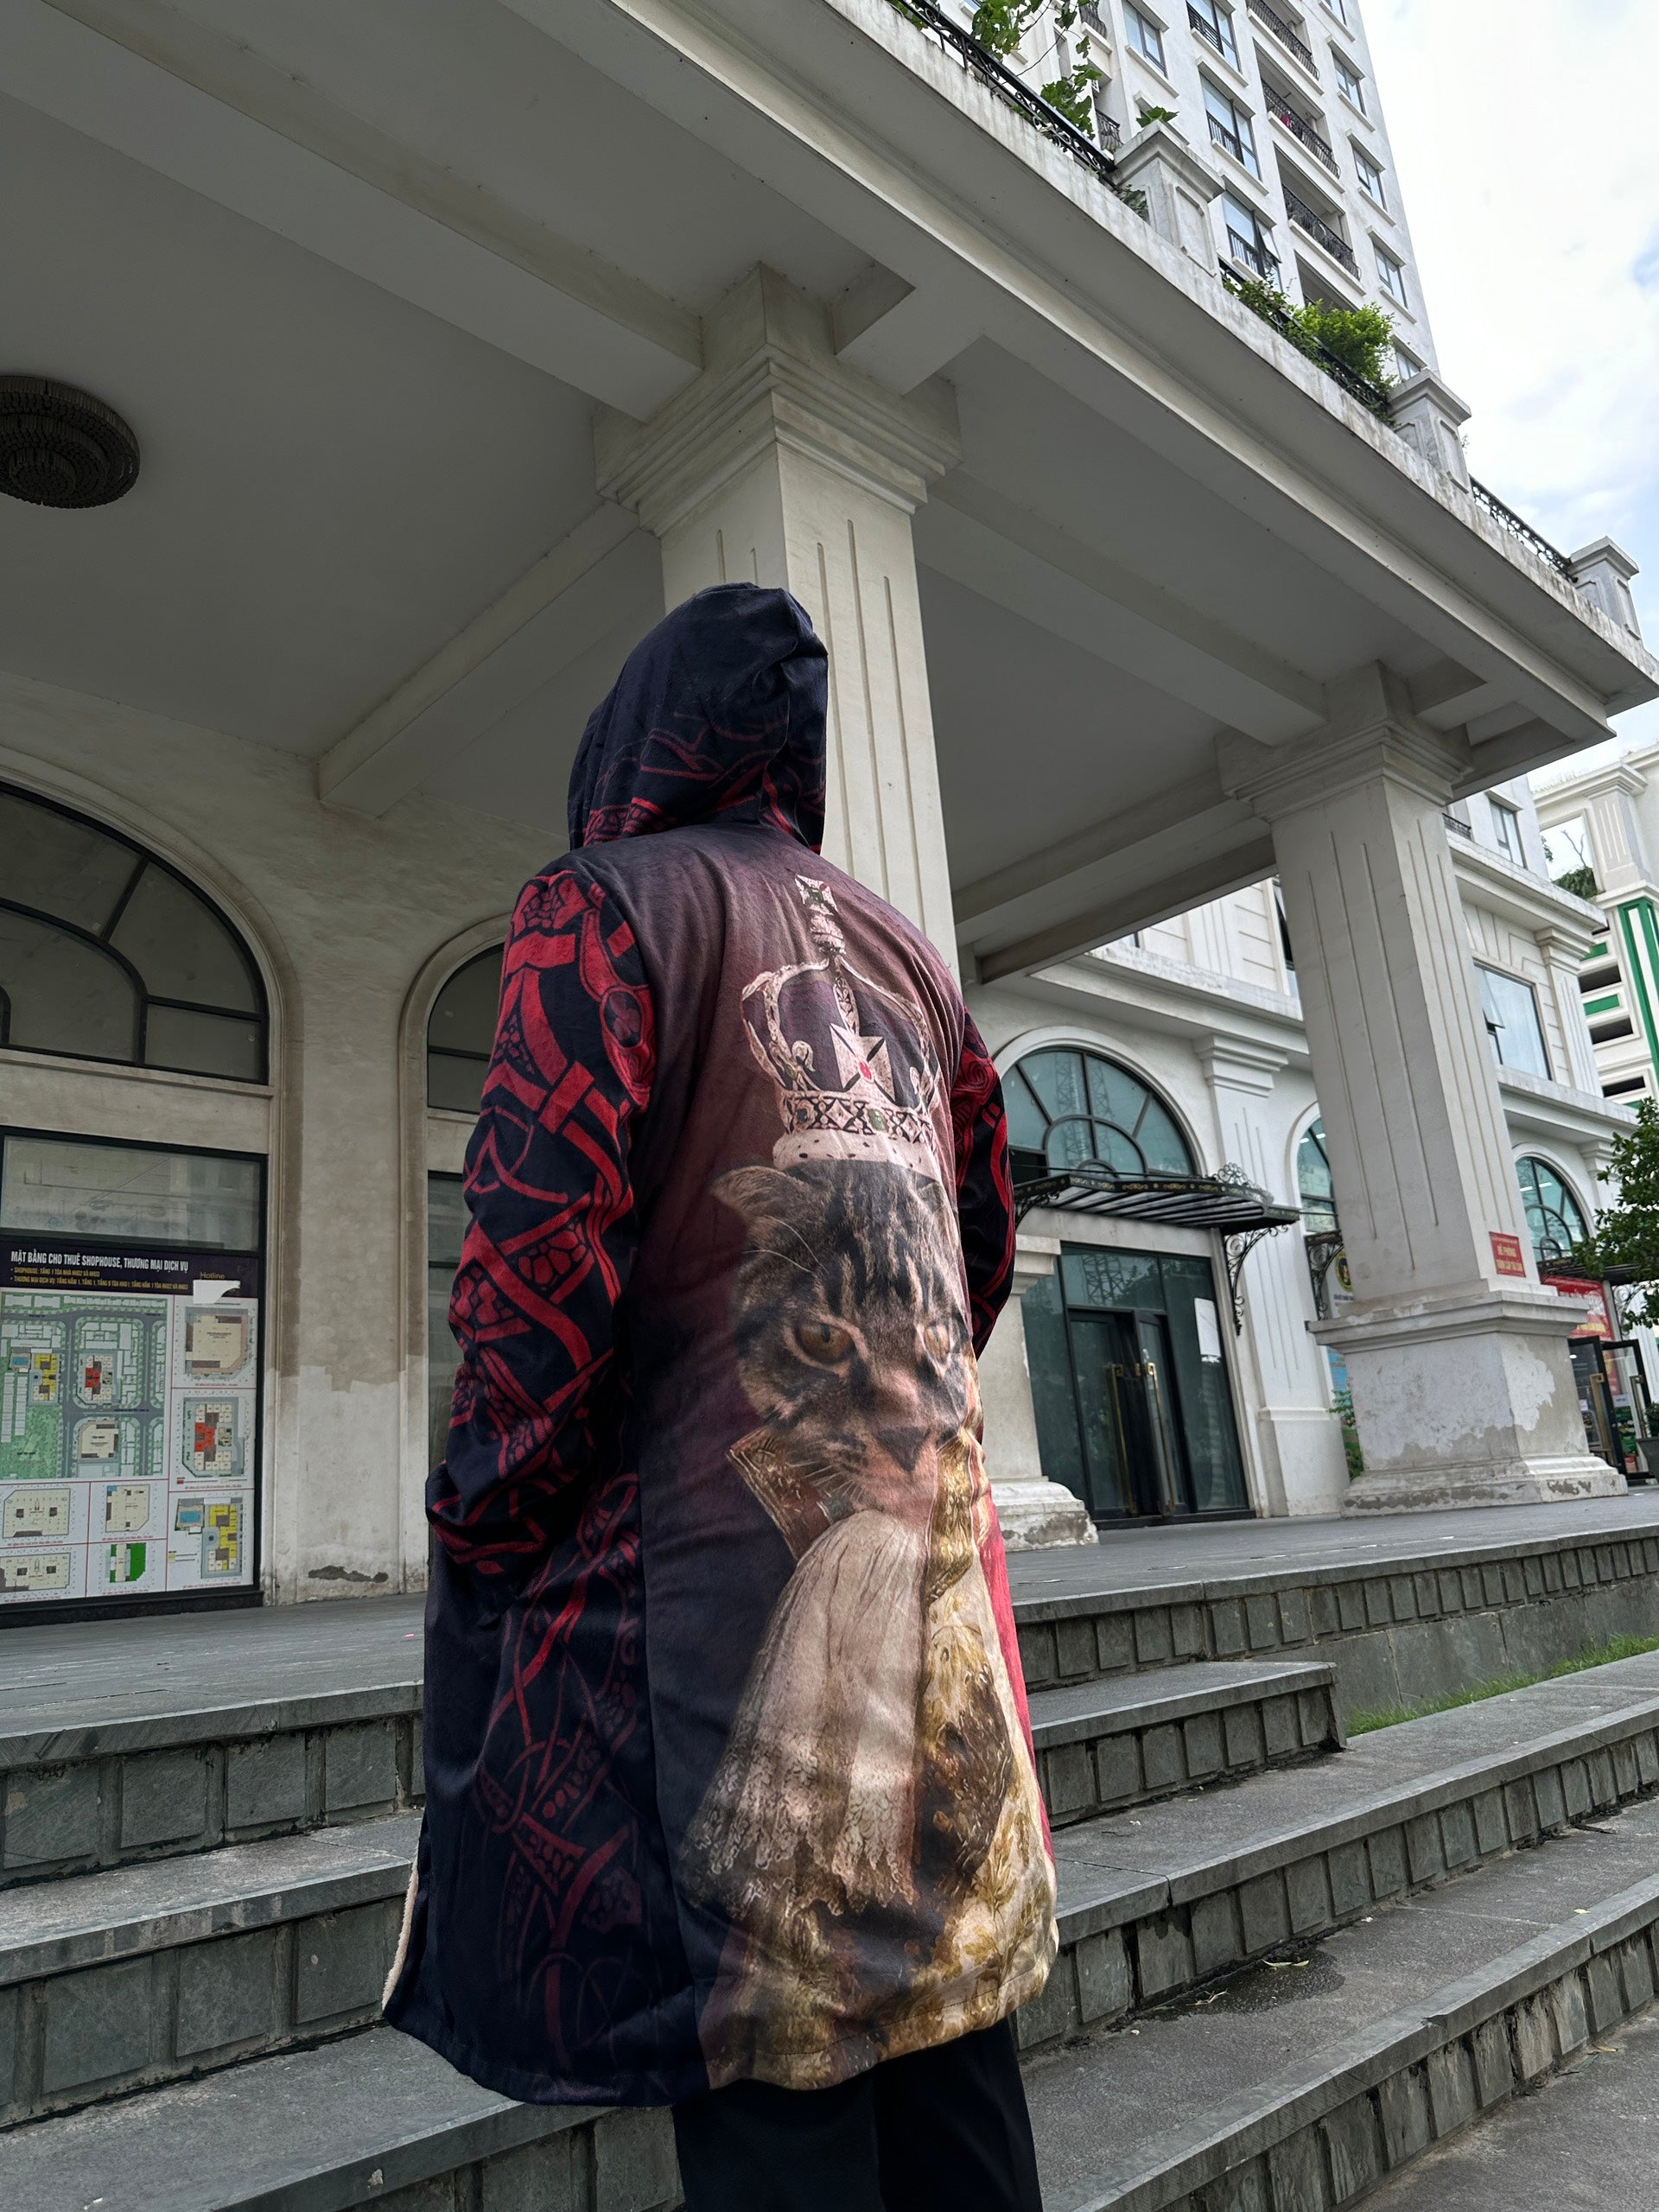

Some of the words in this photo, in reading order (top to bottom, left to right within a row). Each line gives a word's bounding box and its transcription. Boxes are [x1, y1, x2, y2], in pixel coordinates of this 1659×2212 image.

[10, 1249, 27, 1265] MẶT
[28, 1249, 47, 1263] BẰNG
[48, 1253, 62, 1265] CHO
[64, 1253, 80, 1266] THUÊ
[81, 1255, 123, 1269] SHOPHOUSE,
[124, 1257, 149, 1269] THƯƠNG
[150, 1259, 162, 1273] MẠI
[163, 1261, 179, 1273] DỊCH
[180, 1261, 188, 1274] VỤ
[200, 1271, 226, 1280] Hotline
